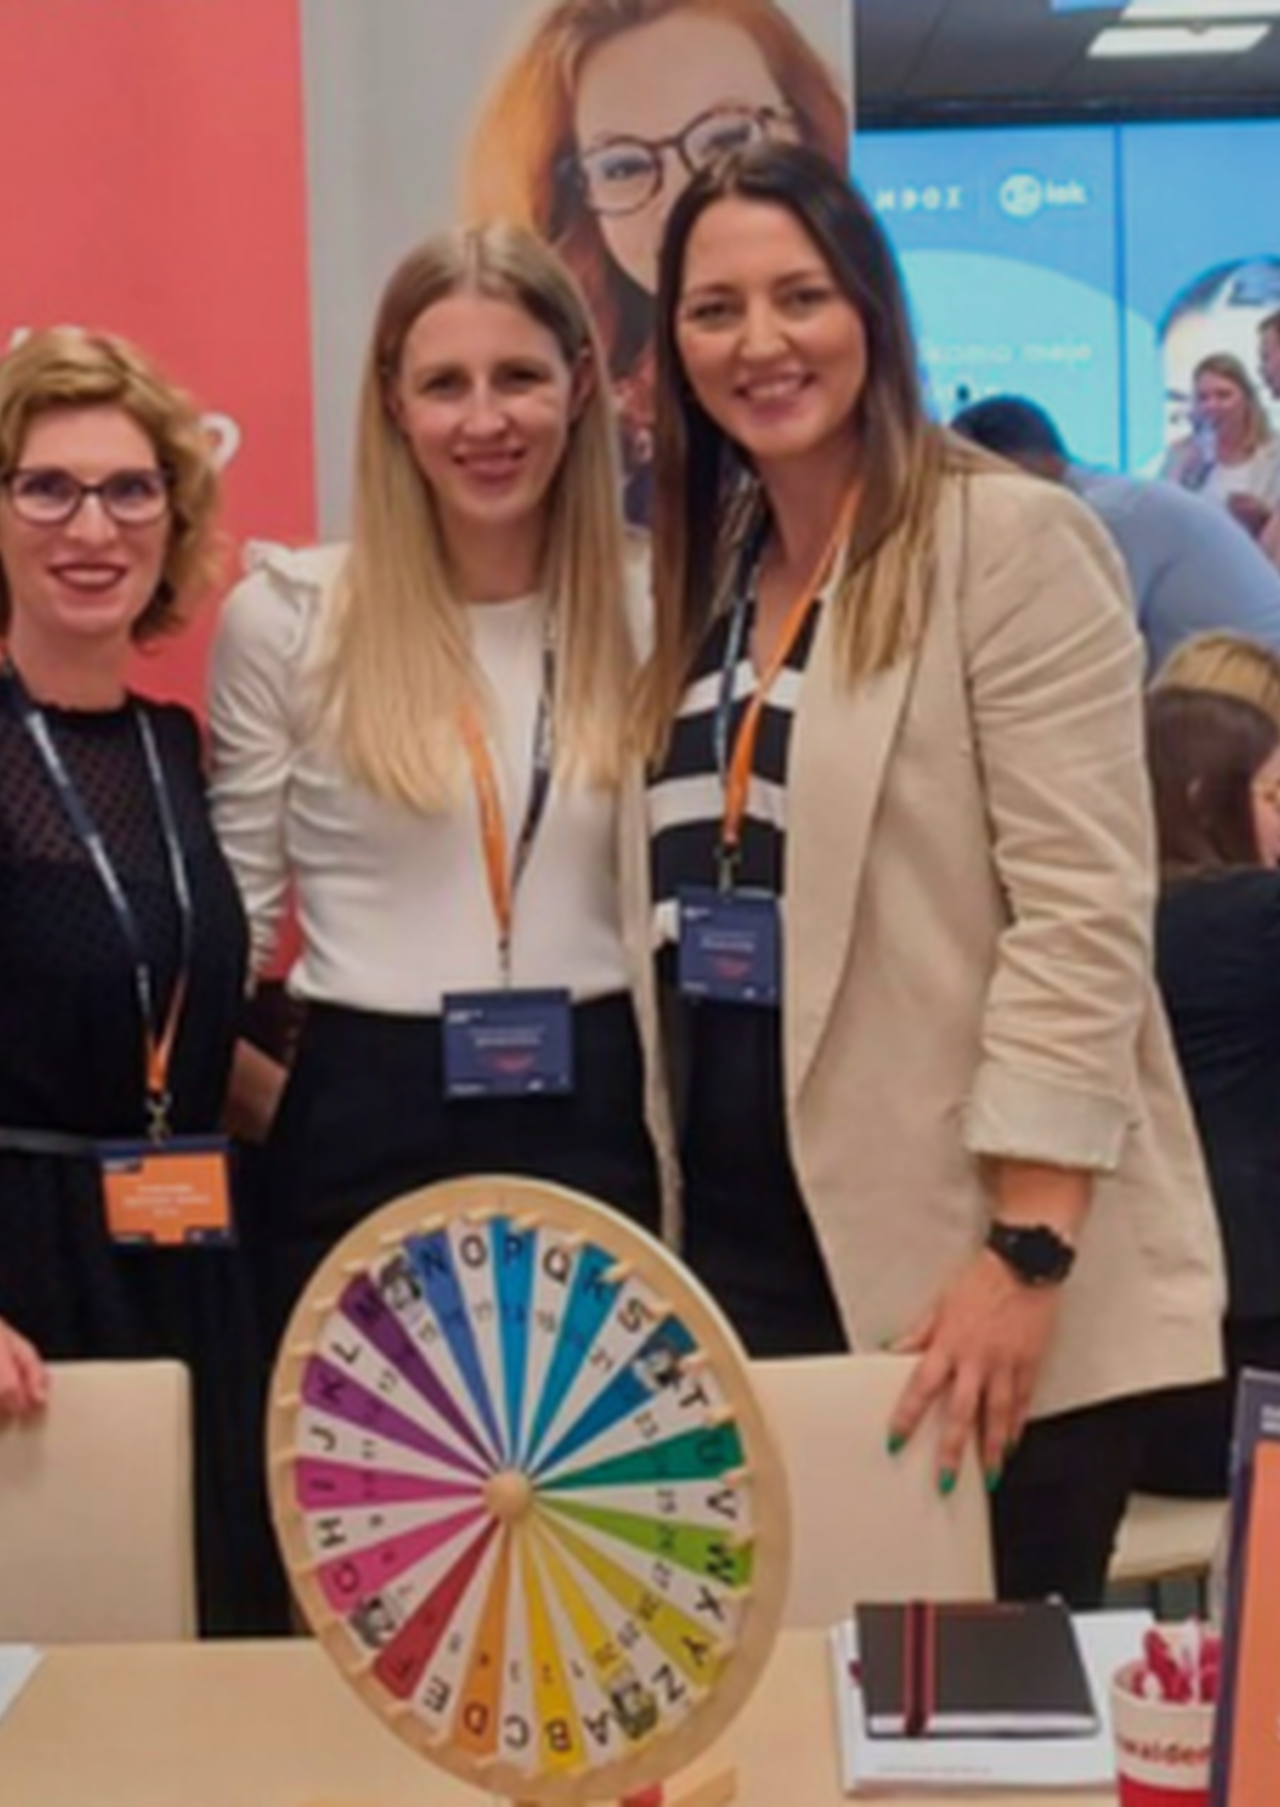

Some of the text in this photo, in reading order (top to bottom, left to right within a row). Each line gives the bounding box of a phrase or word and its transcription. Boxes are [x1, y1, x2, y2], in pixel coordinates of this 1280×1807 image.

[460, 1234, 487, 1268] O
[463, 1701, 489, 1737] D
[503, 1714, 531, 1750] C
[545, 1718, 572, 1754] B
